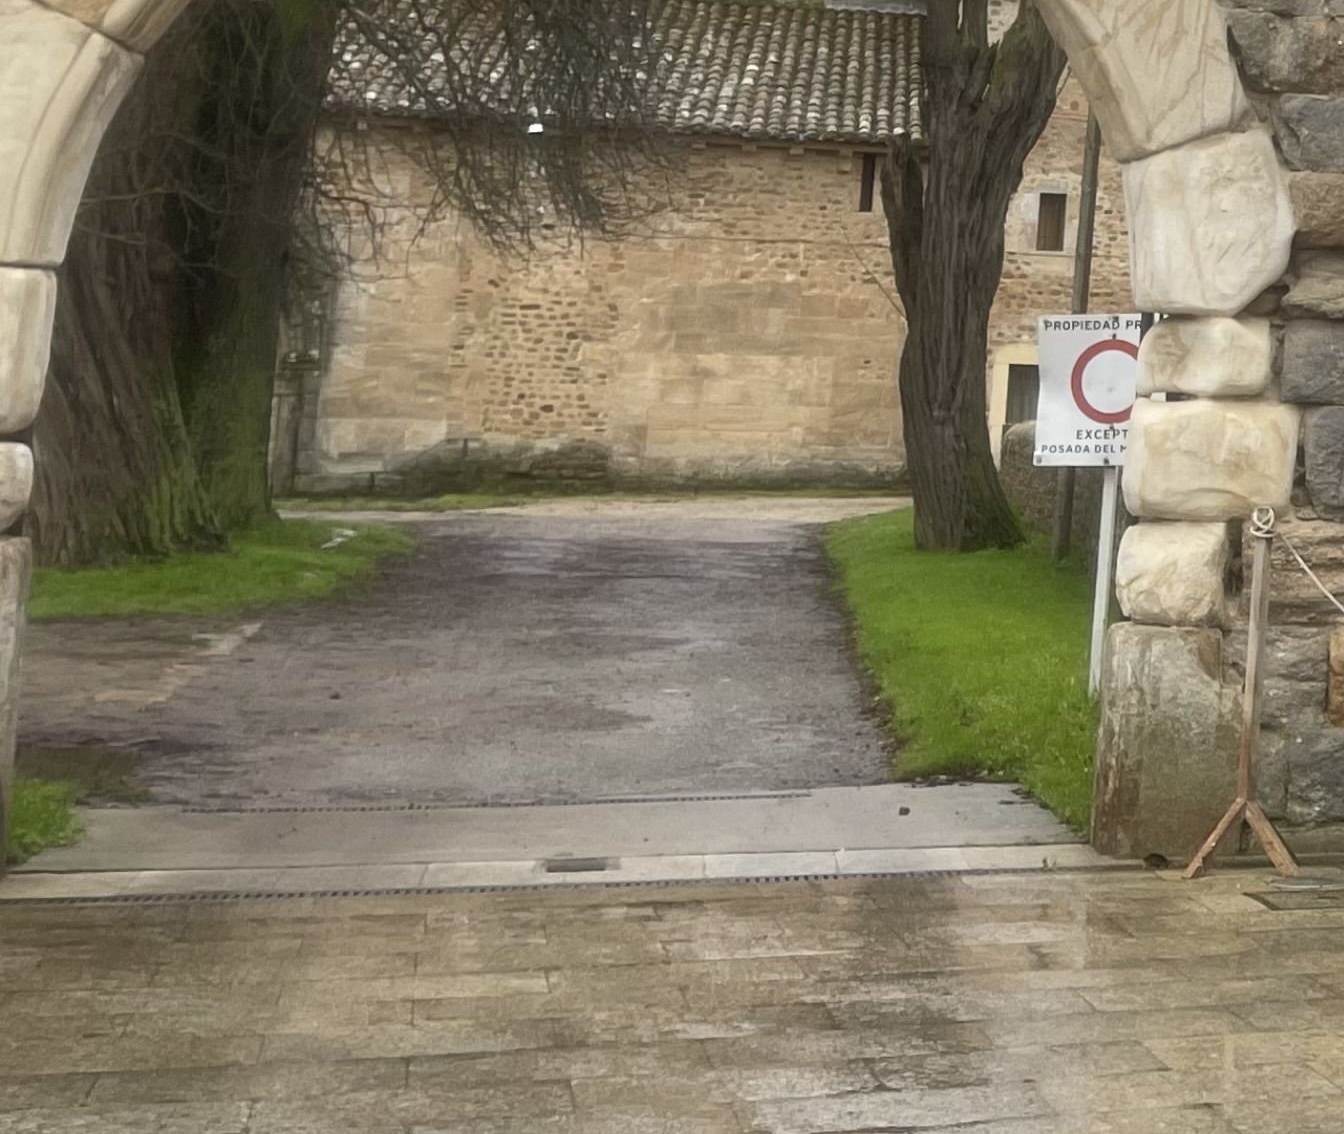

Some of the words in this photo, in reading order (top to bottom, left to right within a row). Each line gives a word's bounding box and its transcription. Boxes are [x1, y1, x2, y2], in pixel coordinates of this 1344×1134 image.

[1045, 320, 1120, 331] PROPIEDAD
[1041, 444, 1090, 453] POSADA
[1094, 444, 1116, 453] DEL
